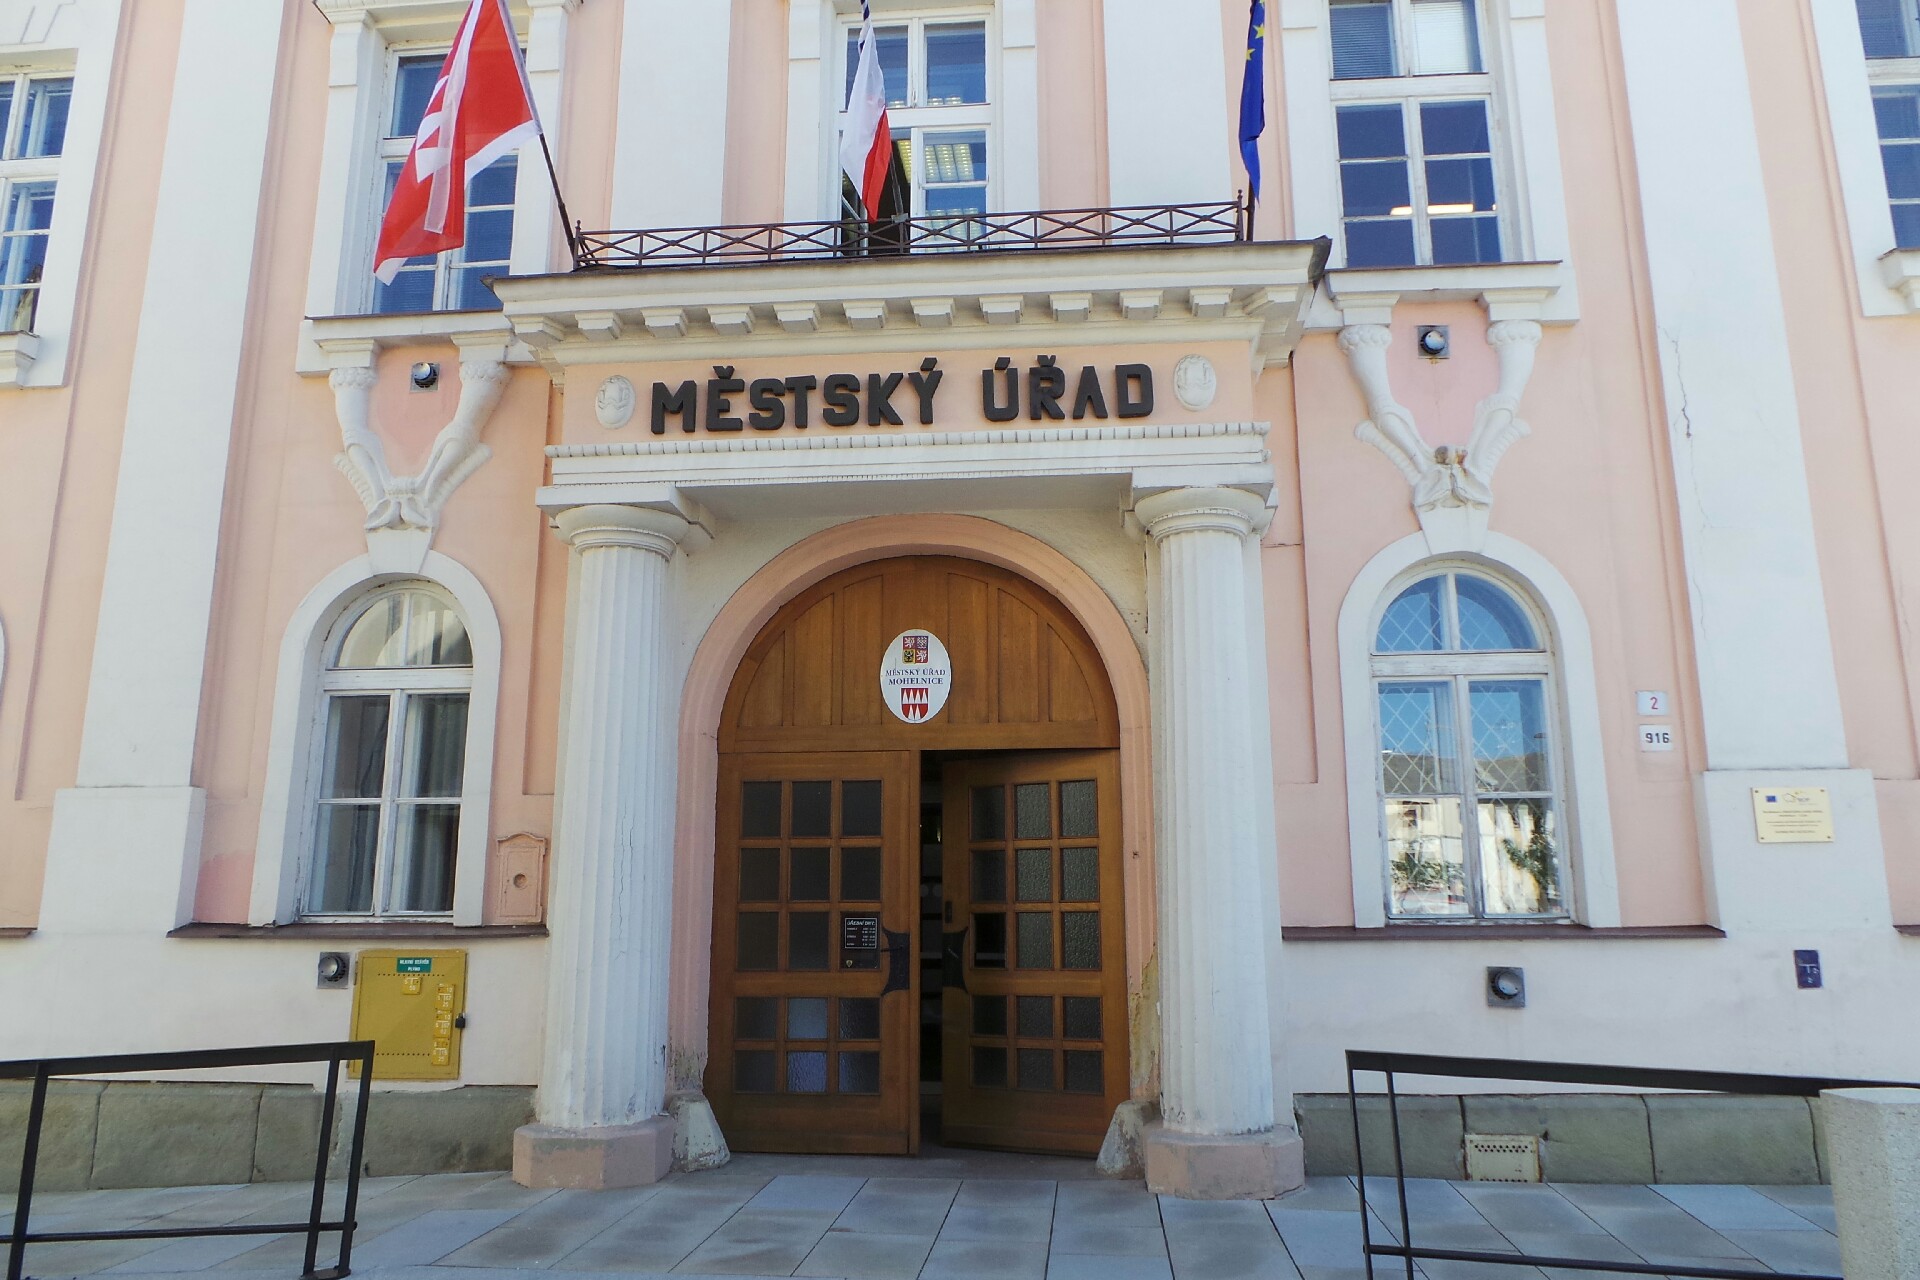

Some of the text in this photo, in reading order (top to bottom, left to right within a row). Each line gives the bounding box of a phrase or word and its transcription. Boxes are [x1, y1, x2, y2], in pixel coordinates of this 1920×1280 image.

[650, 354, 1154, 435] MĚSTSKÝ ÚŘAD
[886, 668, 945, 677] MĚSTSKÝ ÚŘAD
[888, 677, 944, 685] MOHELNICE
[1649, 696, 1659, 710] 2
[1645, 732, 1670, 744] 916
